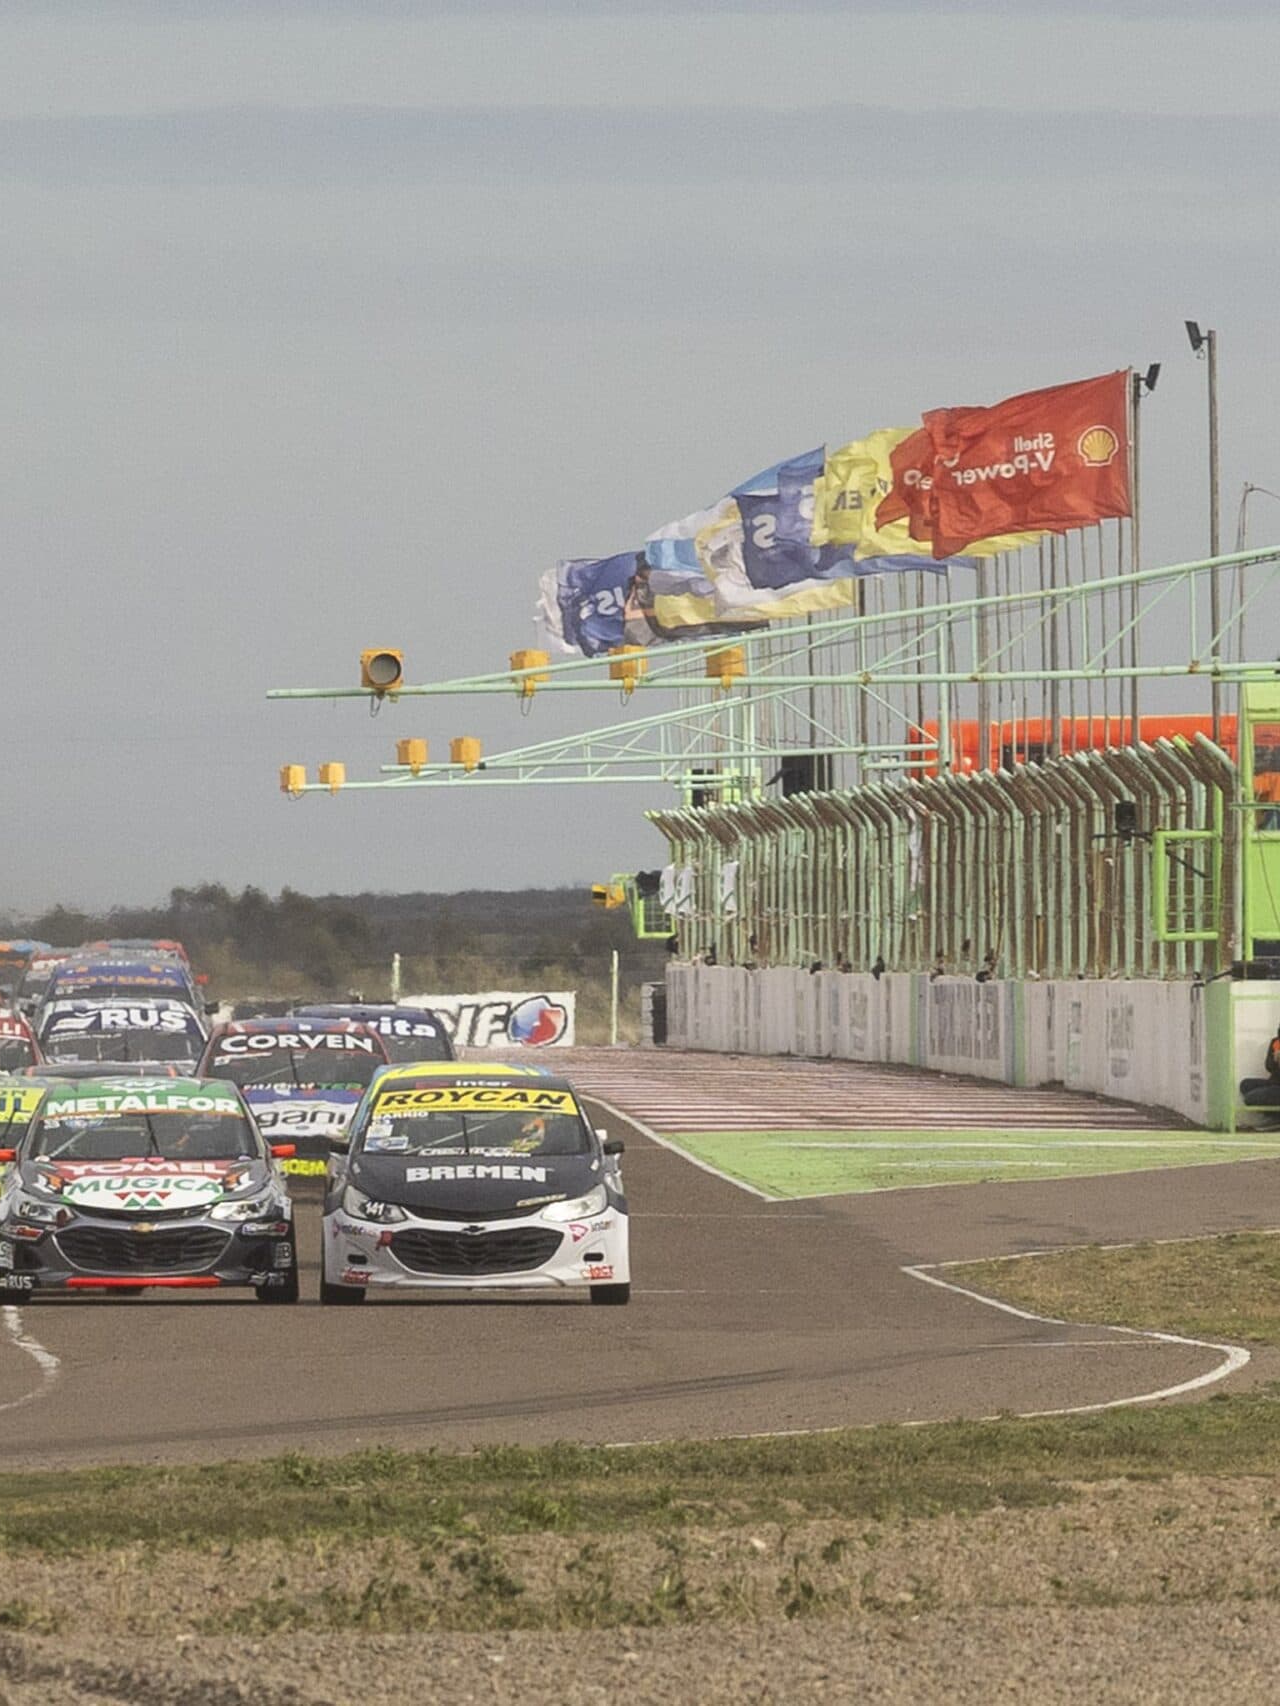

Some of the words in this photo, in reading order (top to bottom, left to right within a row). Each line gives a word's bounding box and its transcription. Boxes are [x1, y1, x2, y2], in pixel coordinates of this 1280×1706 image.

[101, 1009, 189, 1033] RUS
[221, 1033, 373, 1053] CORVEN
[46, 1096, 238, 1116] METALFOR
[382, 1091, 567, 1107] ROYCAN
[62, 1162, 228, 1176] YOMEL
[406, 1165, 546, 1182] BREMEN
[68, 1177, 221, 1195] MUGICA
